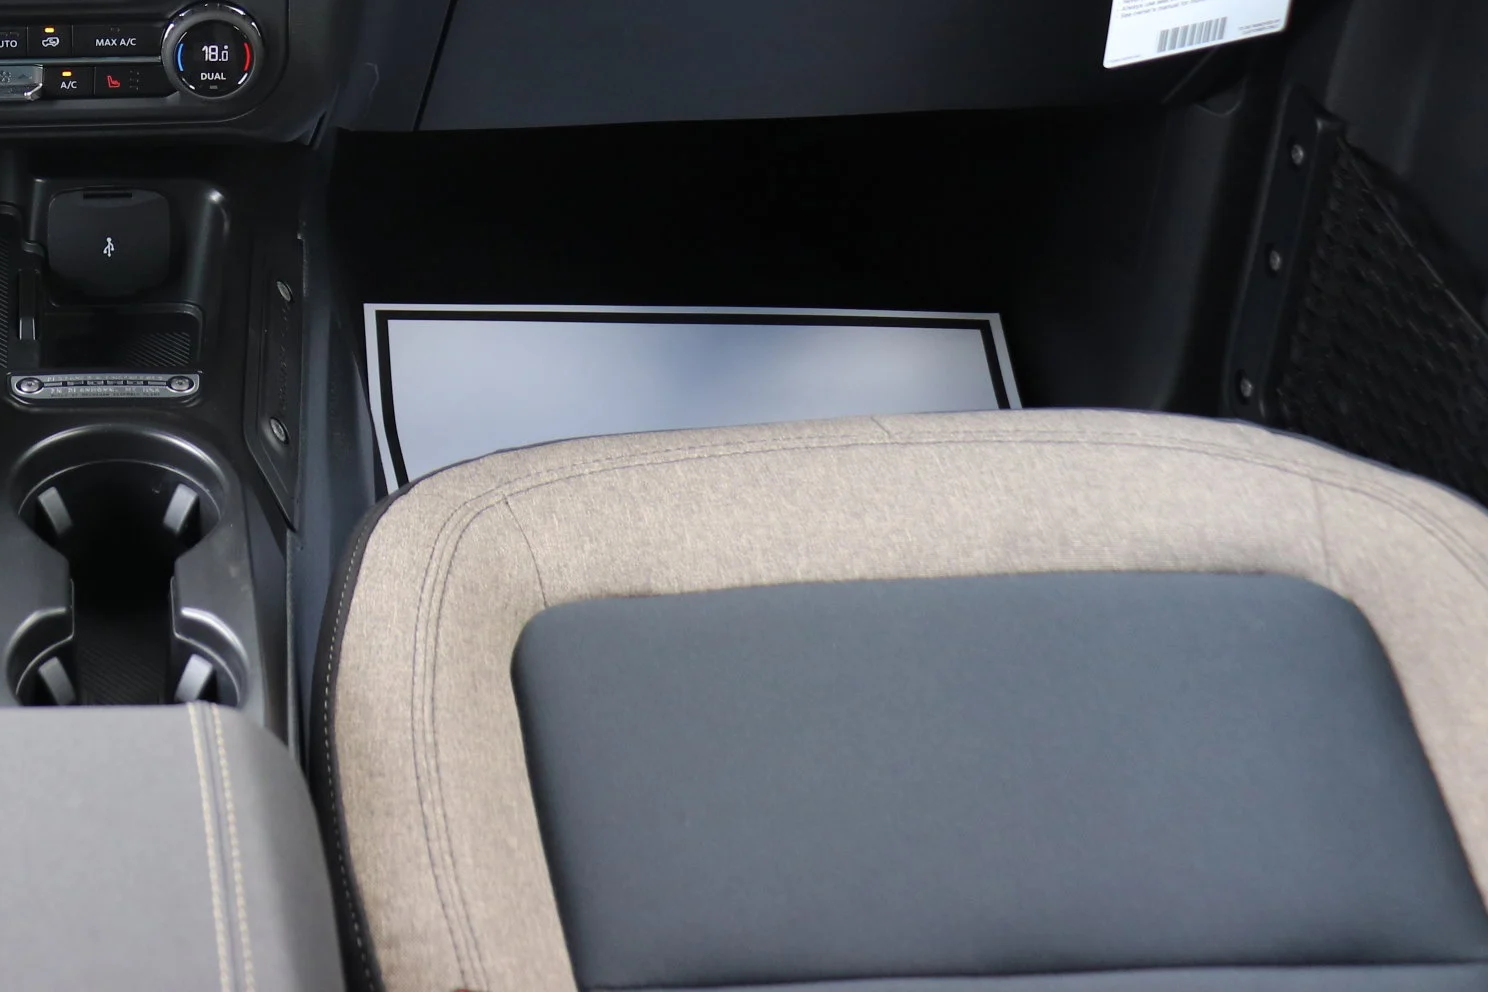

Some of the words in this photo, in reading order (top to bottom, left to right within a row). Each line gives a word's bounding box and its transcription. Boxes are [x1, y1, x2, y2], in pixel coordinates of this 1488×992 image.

[95, 38, 117, 47] MAX
[119, 37, 137, 47] A/C
[200, 72, 227, 81] DUAL
[60, 80, 78, 90] A/C
